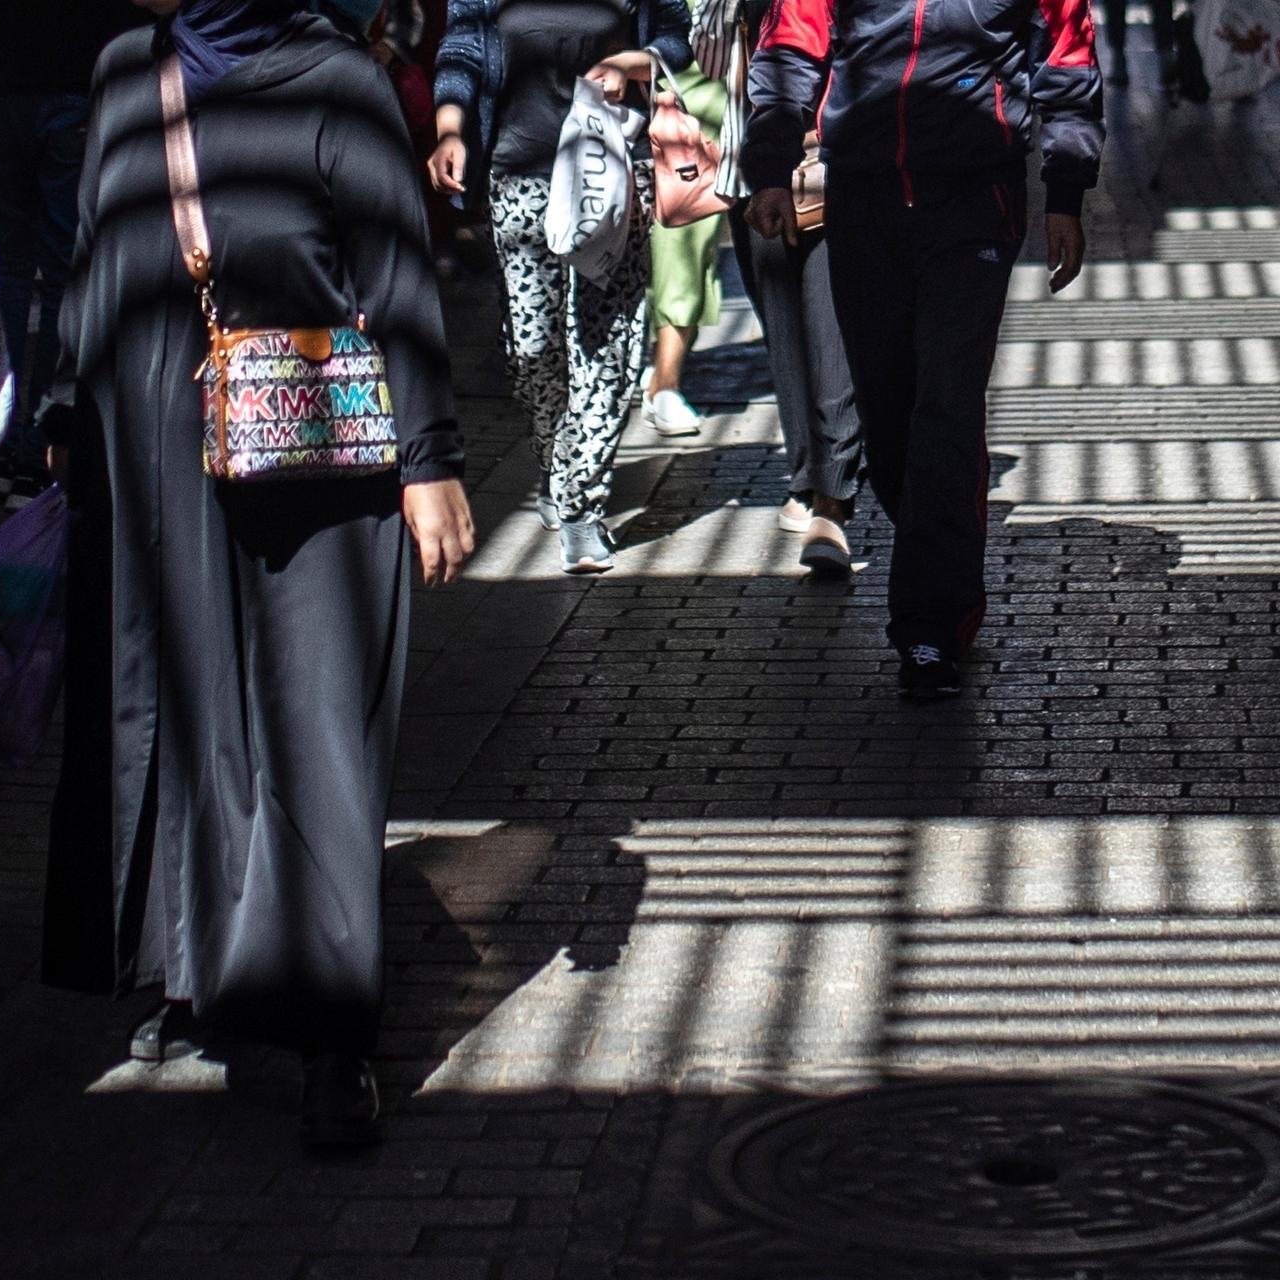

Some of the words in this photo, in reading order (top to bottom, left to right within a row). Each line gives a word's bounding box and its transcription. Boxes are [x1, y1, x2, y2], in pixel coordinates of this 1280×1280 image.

[346, 355, 375, 375] MK
[227, 385, 276, 423] MK
[277, 386, 330, 420] MK
[329, 381, 380, 417] MK
[227, 423, 263, 450] MK
[263, 422, 301, 448] MK
[334, 419, 366, 442] MK
[365, 416, 398, 441] MK
[358, 445, 384, 465] MK
